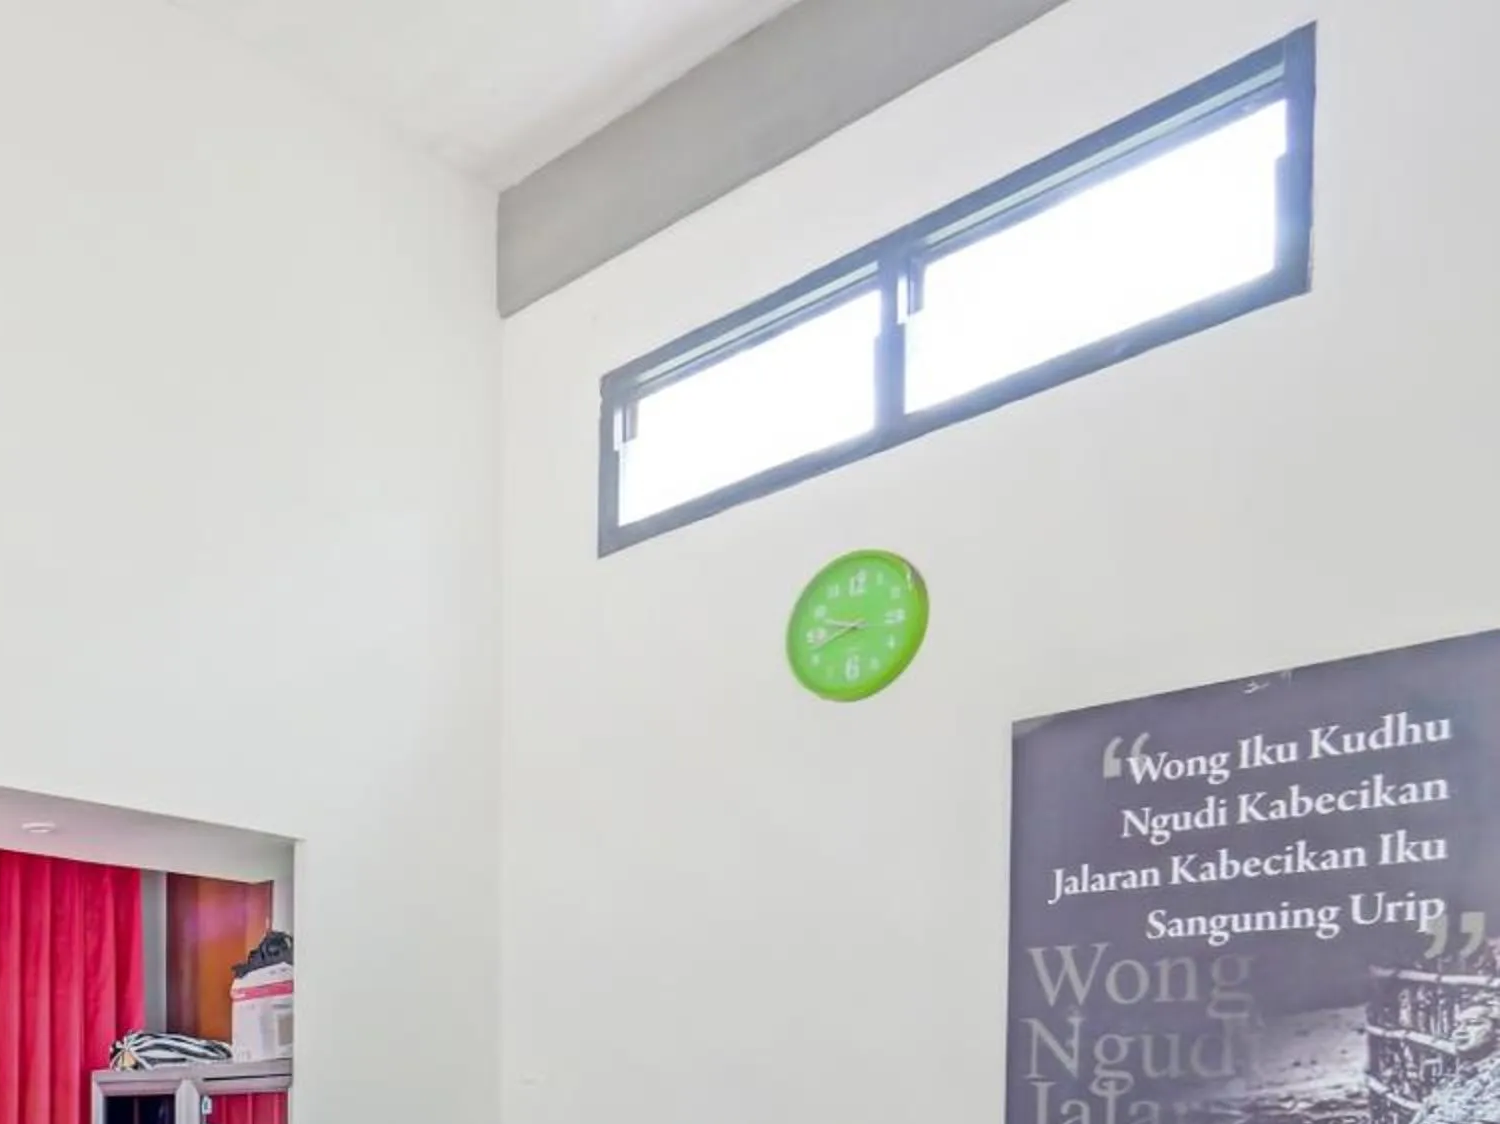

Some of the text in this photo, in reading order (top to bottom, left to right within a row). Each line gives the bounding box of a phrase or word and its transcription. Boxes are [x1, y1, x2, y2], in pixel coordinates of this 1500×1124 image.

[1126, 751, 1231, 785] Wong
[1237, 734, 1298, 769] Iku
[1308, 711, 1452, 759] Kudhu
[1120, 773, 1449, 846] Ngudi Kabecikan
[1047, 829, 1448, 905] Jalaran Kabecikan Iku
[1146, 901, 1341, 947] Sanguning
[1349, 891, 1446, 933] Urip
[1025, 941, 1258, 1018] Wong
